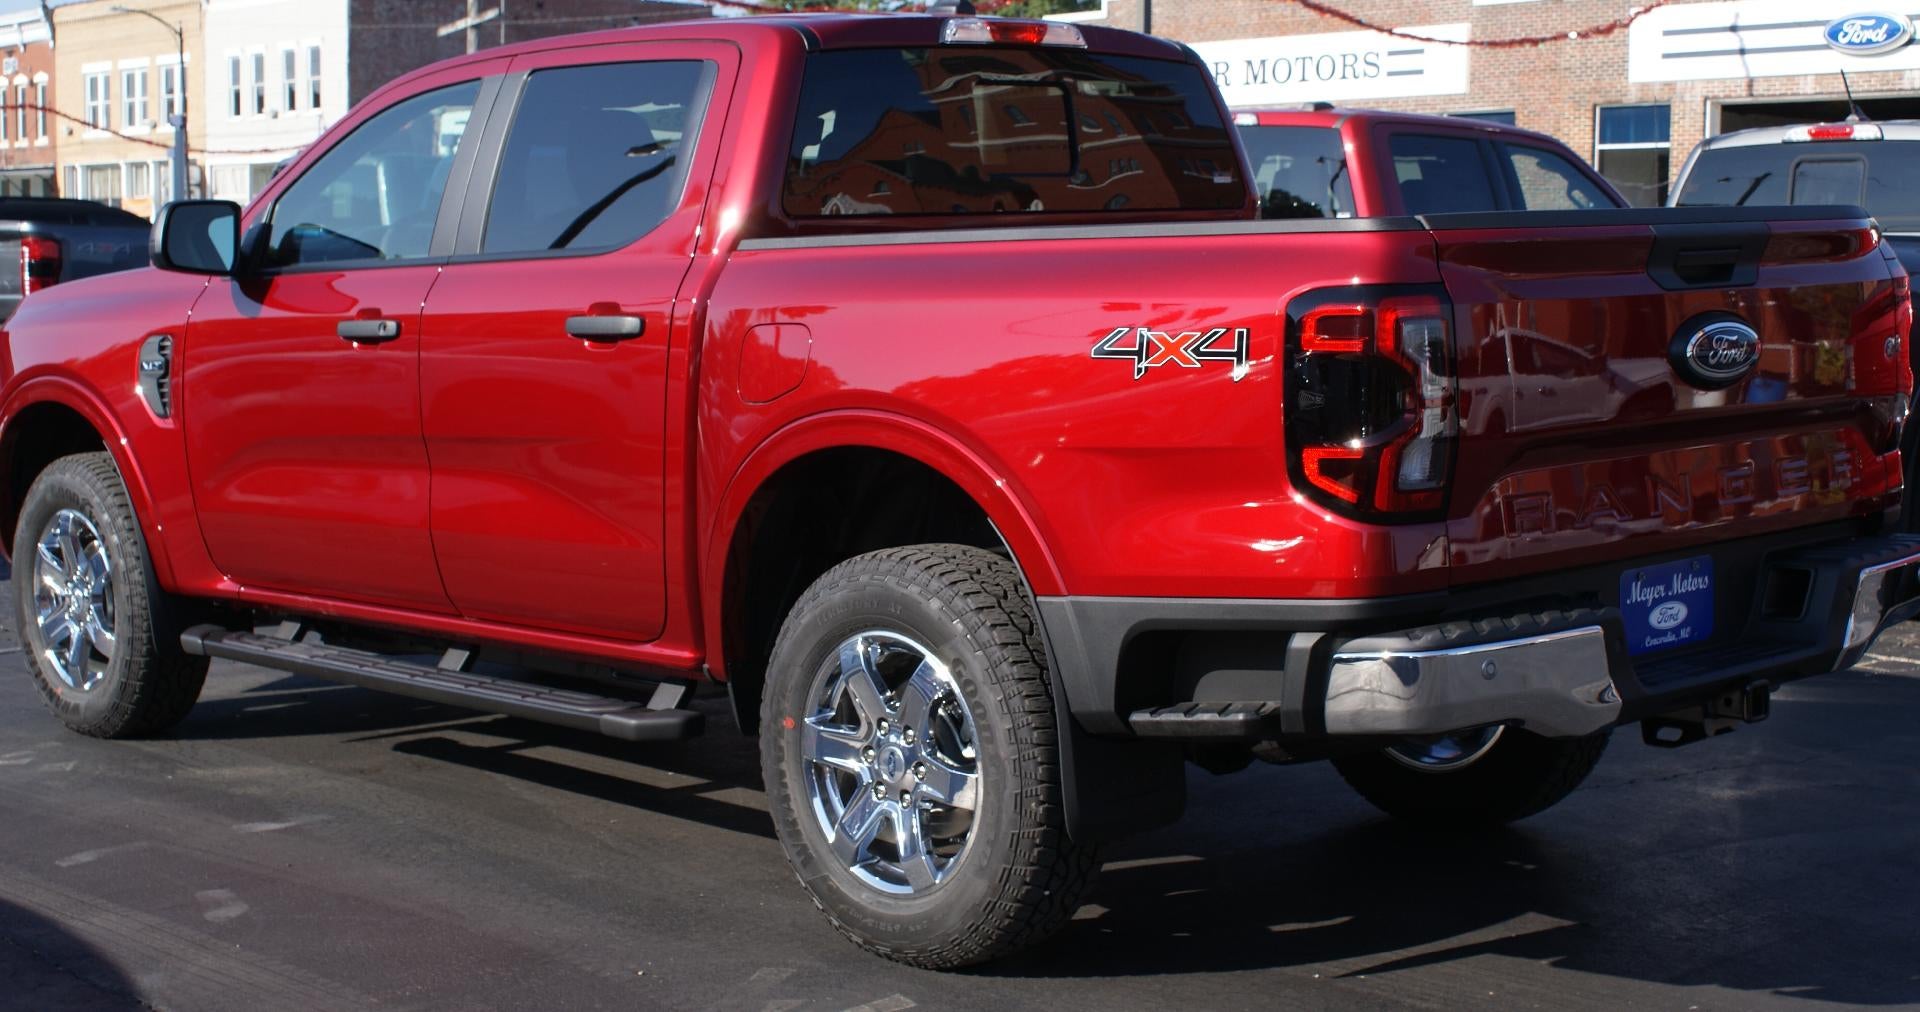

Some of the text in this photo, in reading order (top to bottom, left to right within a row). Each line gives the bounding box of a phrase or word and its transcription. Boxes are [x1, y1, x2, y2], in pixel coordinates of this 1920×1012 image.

[1837, 18, 1888, 44] Ford
[1245, 51, 1381, 85] MOTORS
[1708, 334, 1748, 365] Ford
[1626, 572, 1710, 608] Meyer Motors
[1656, 606, 1681, 625] Ford
